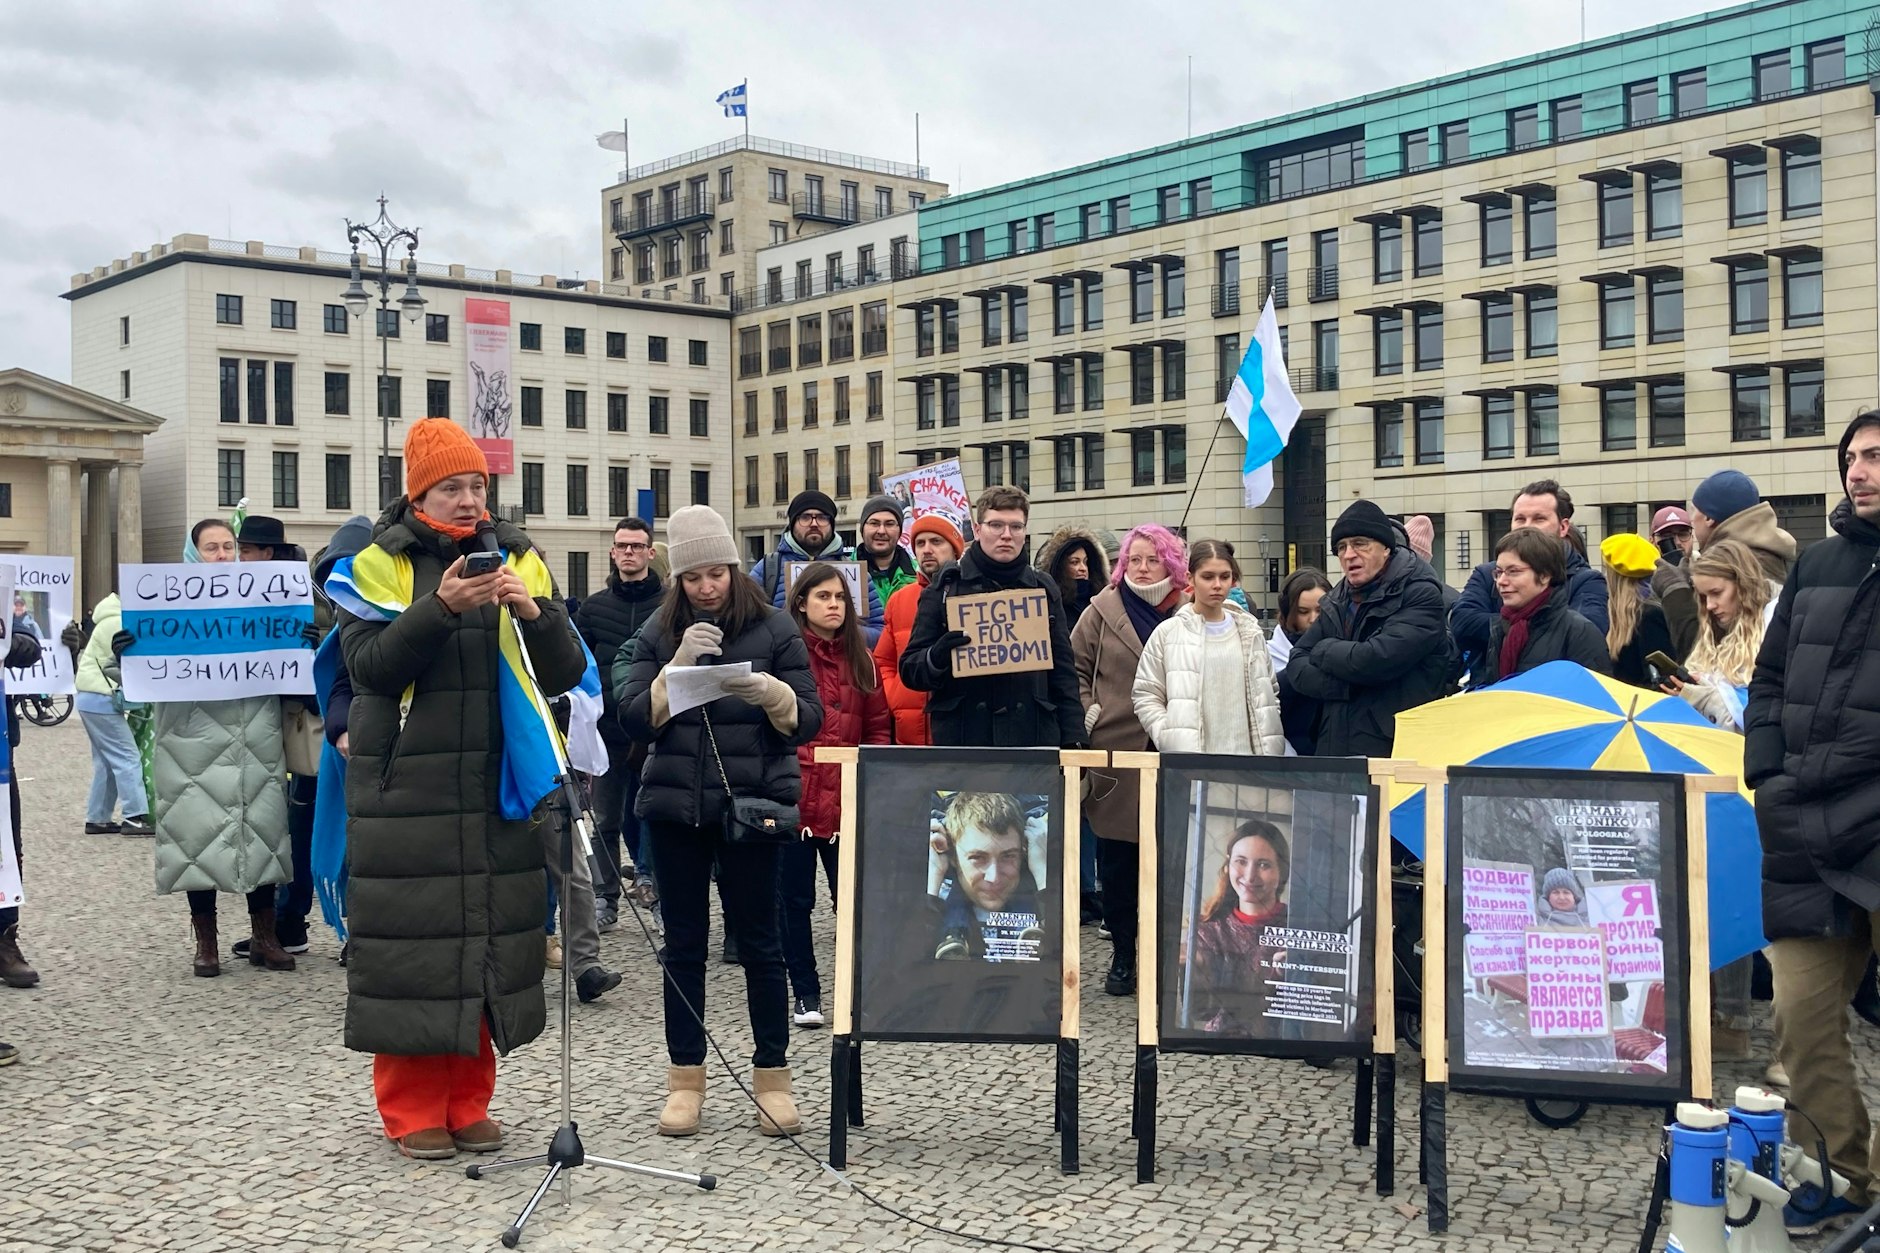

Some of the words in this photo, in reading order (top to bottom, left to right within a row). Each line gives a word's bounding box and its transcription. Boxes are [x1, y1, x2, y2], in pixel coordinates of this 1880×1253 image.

[910, 477, 968, 512] CHANGE
[15, 565, 71, 586] kanov
[136, 573, 309, 602] СВОБОДУ
[958, 595, 1046, 628] FIGHT
[978, 623, 1018, 644] FOR
[956, 640, 1048, 672] FREEDOM!
[148, 658, 299, 682] УЗНИКАМ
[1571, 806, 1634, 816] TAMARA
[1467, 895, 1527, 911] Марина
[1622, 886, 1654, 916] Я
[988, 919, 1038, 928] VYGOVSKIY
[991, 912, 1035, 920] VALENTIN
[1265, 926, 1348, 943] ALEXANDRA
[1528, 934, 1600, 952] Первой
[1260, 936, 1352, 953] SKOCHILENKO
[1606, 942, 1659, 956] ойны
[1272, 961, 1348, 974] SAINT-PETERSBURG
[1474, 962, 1484, 973] на
[1530, 953, 1600, 968] жертвой
[1606, 956, 1662, 978] Украиной
[1530, 970, 1602, 982] войны
[1530, 986, 1602, 1007] является
[1531, 1010, 1604, 1034] правда
